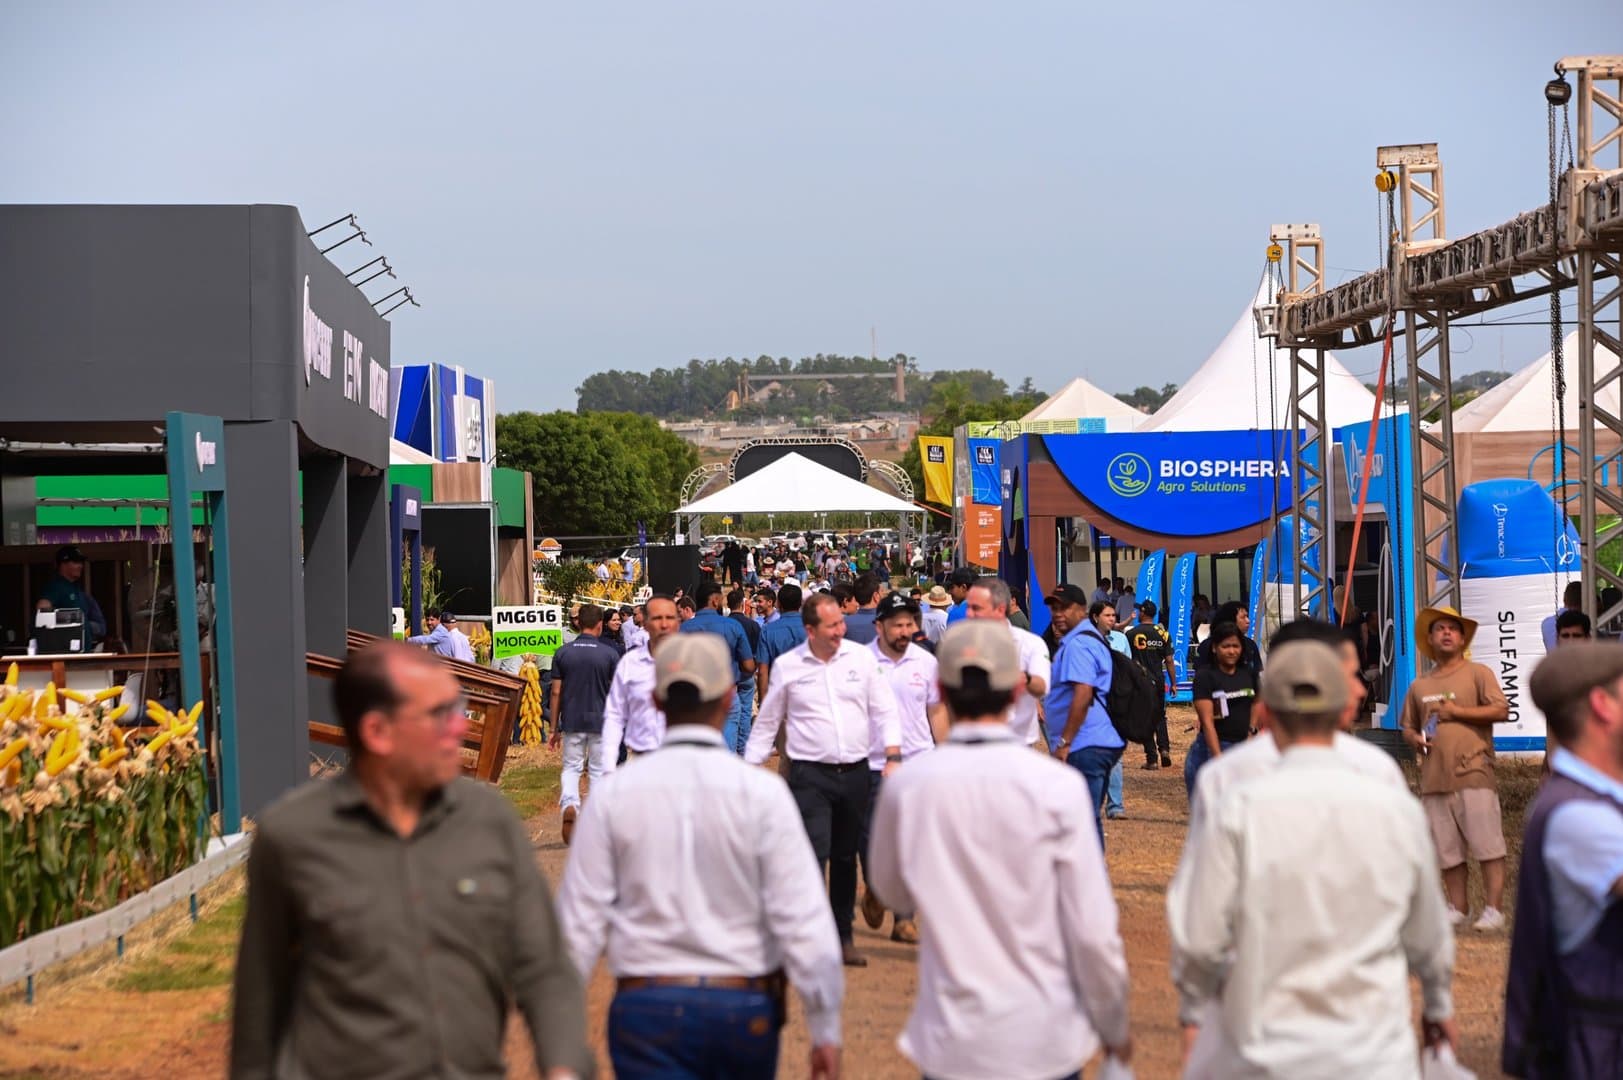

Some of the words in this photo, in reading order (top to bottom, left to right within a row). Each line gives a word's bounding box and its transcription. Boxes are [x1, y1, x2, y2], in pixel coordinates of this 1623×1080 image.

[1160, 459, 1291, 478] BIOSPHERA
[1156, 481, 1185, 495] Agro
[1190, 480, 1247, 492] Solutions
[1146, 557, 1156, 592] AGRO
[1180, 558, 1189, 597] AGRO
[496, 609, 557, 625] MG616
[1175, 599, 1186, 646] Timac
[496, 634, 557, 648] MORGAN
